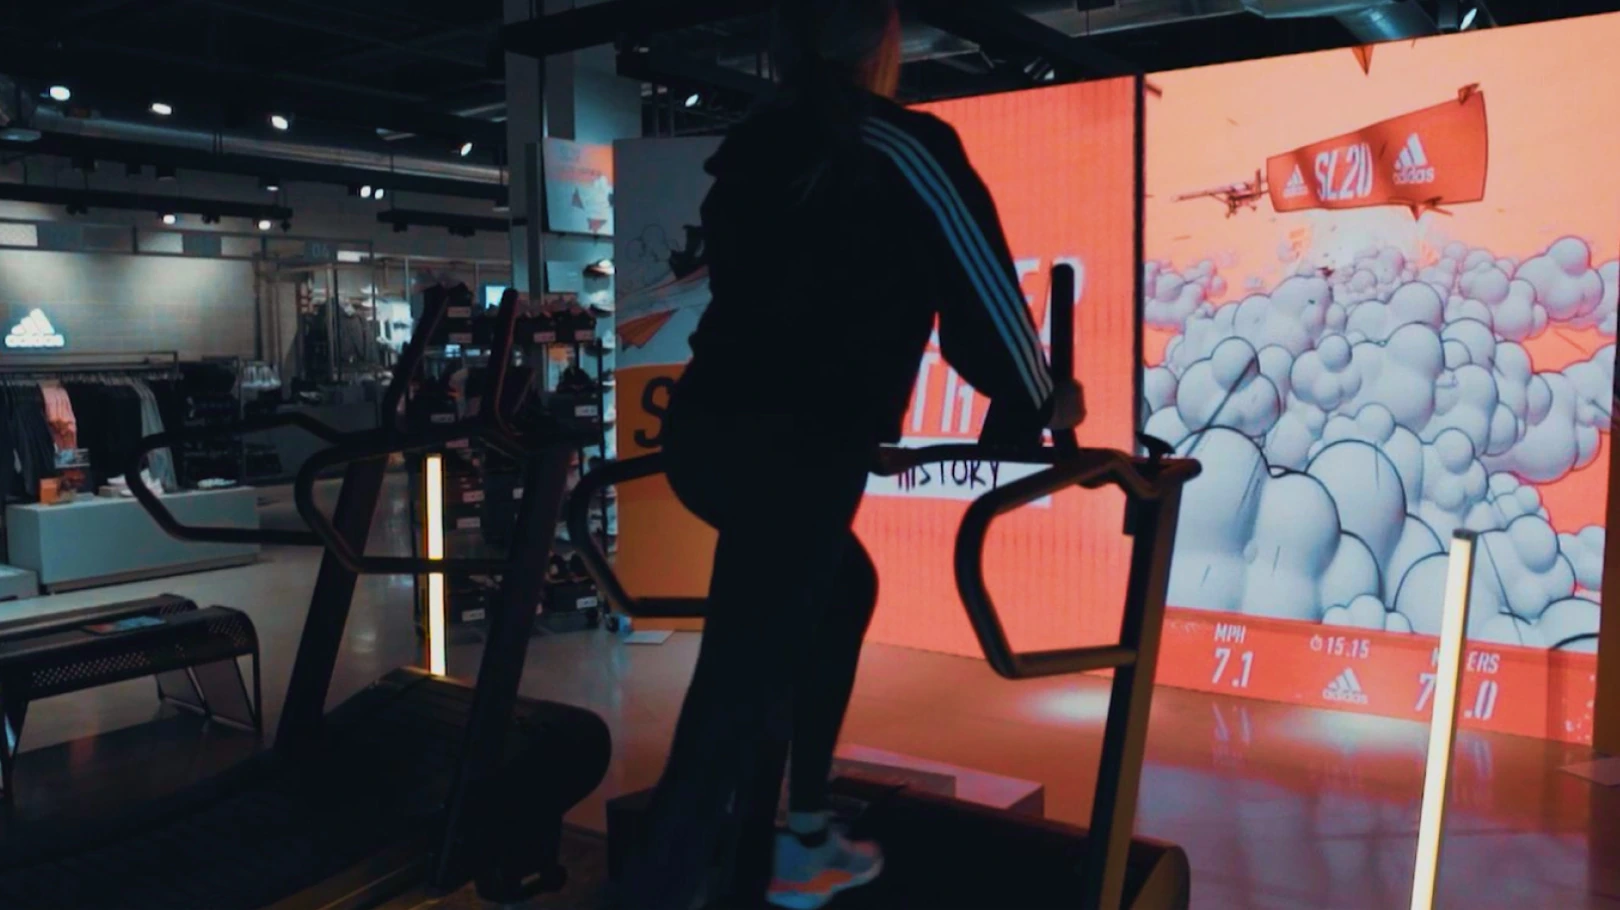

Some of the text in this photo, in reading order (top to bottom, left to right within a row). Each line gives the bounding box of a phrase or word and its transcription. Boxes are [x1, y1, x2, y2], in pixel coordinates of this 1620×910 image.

[1315, 142, 1373, 201] SL20
[1392, 166, 1435, 185] adidas
[1214, 623, 1247, 644] MPH
[1327, 636, 1370, 659] 15.15
[1212, 647, 1254, 688] 7.1
[1322, 688, 1369, 705] adidas
